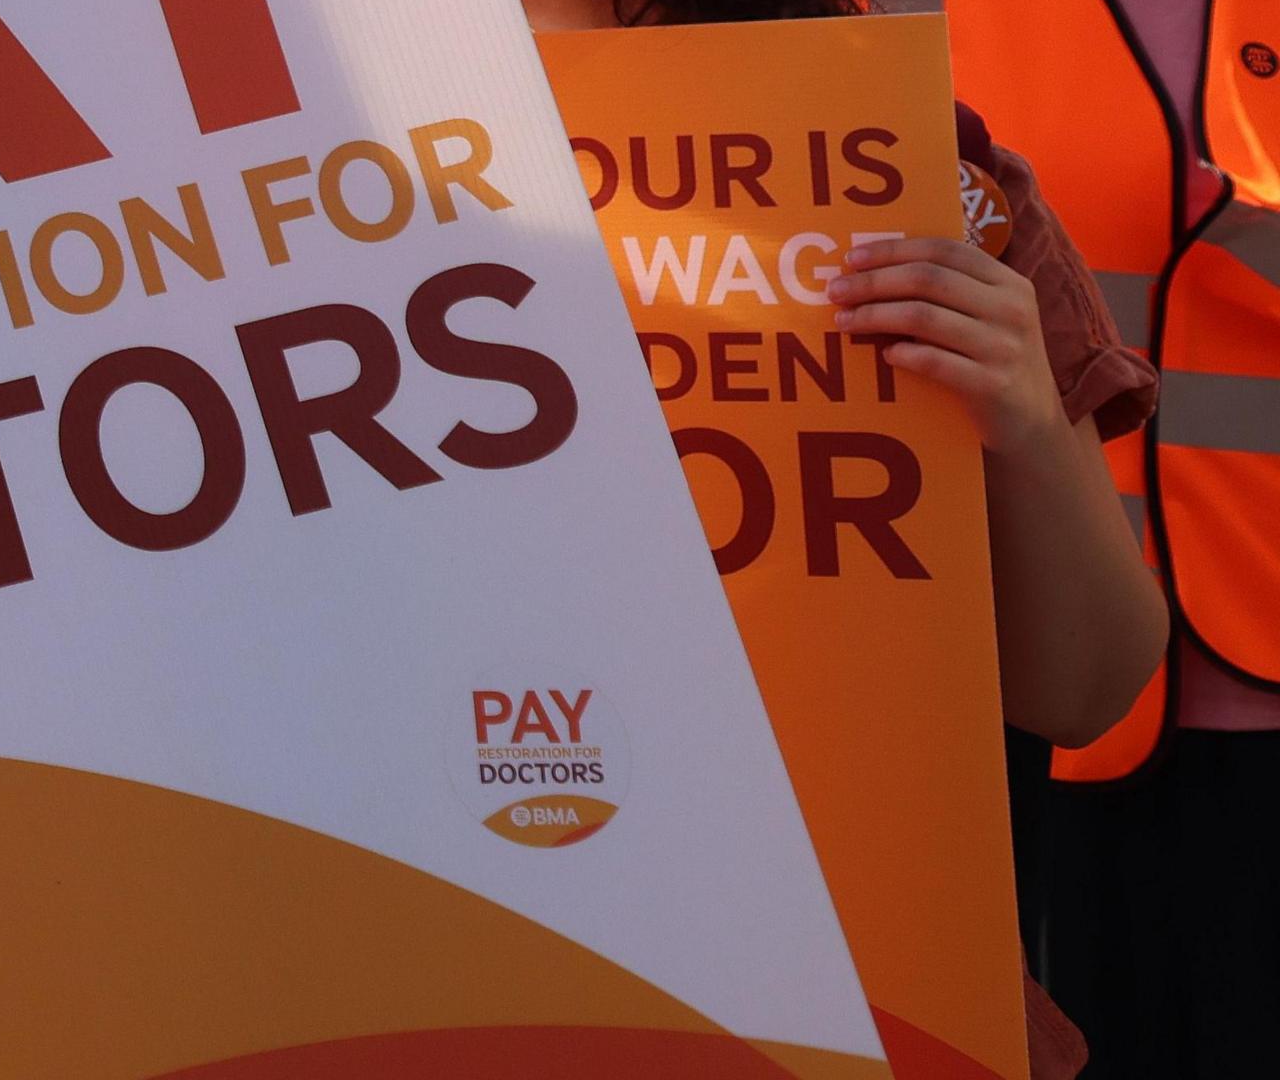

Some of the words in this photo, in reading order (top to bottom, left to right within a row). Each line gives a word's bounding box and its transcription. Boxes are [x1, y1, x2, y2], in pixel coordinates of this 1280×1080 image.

[241, 118, 512, 265] FOR
[807, 127, 905, 207] IS
[622, 231, 906, 306] WAG
[471, 689, 593, 745] PAY
[477, 747, 572, 760] RESTORATION
[575, 746, 602, 759] FOR
[479, 762, 605, 785] DOCTORS
[533, 806, 581, 826] BMA
